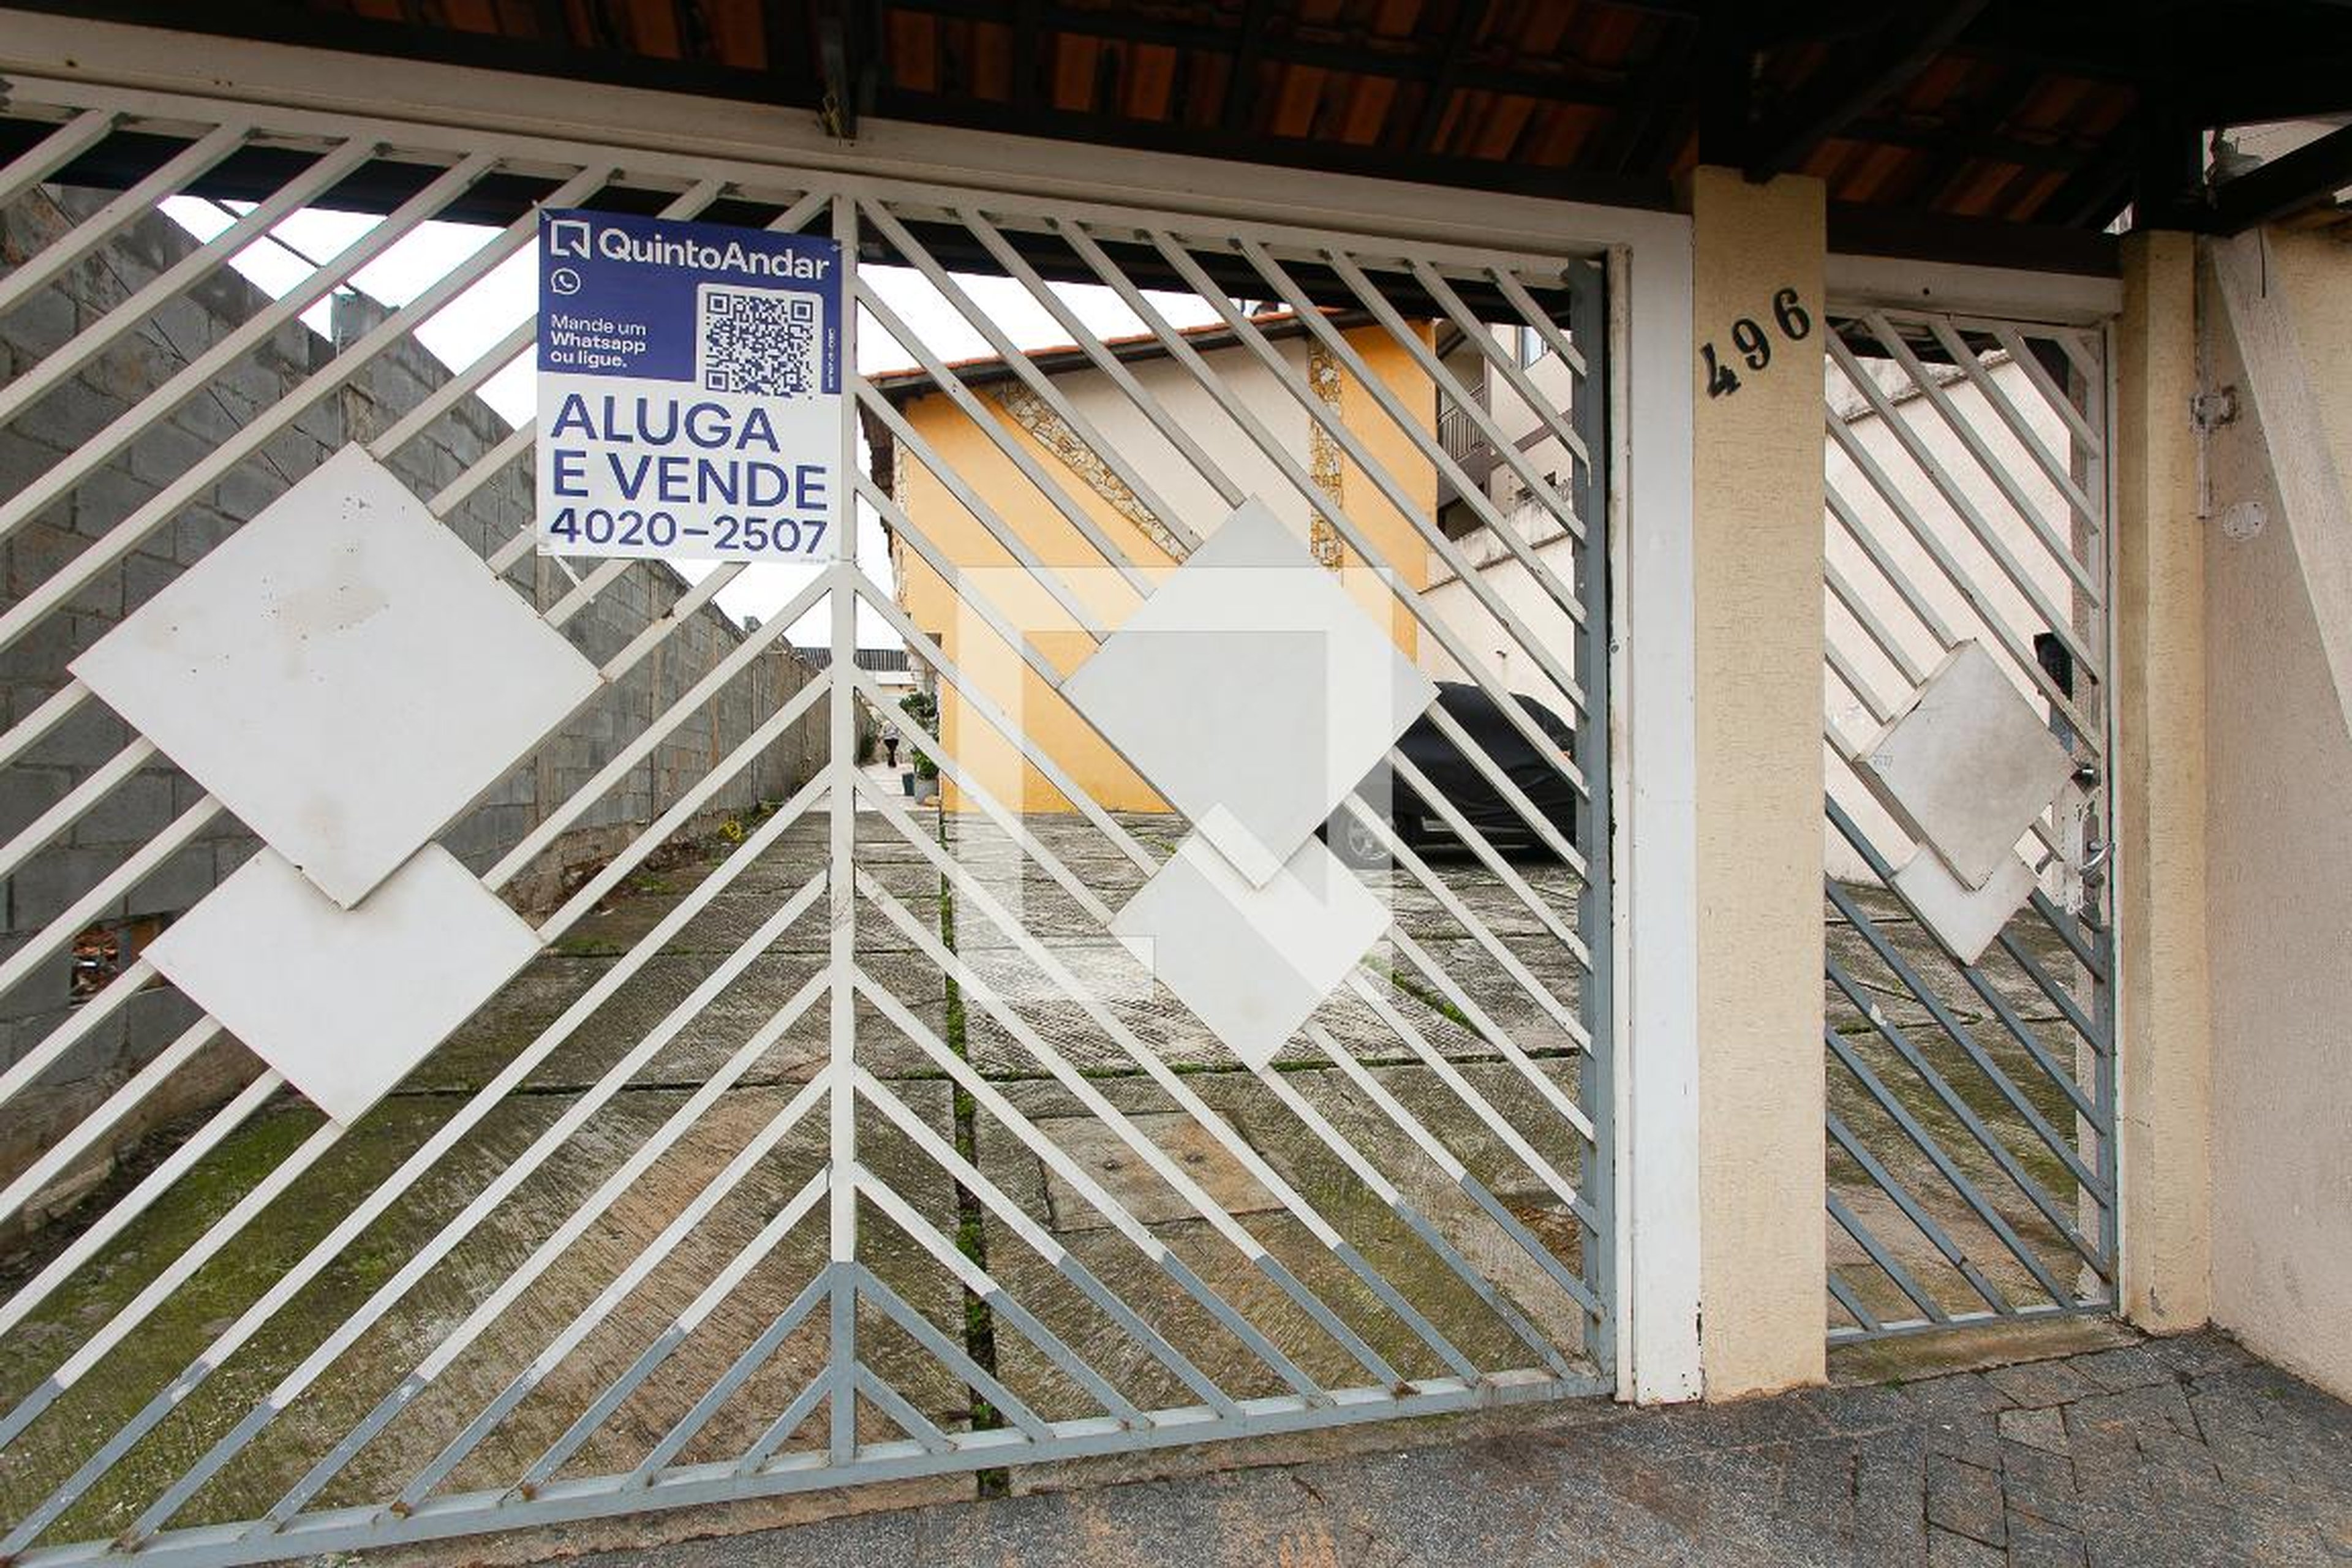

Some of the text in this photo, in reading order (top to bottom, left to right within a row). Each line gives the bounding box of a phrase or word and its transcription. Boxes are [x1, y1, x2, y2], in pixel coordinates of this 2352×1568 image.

[597, 227, 831, 281] QuintoAndar
[551, 313, 647, 336] Mande um
[551, 330, 647, 355] Whatsapp
[1699, 287, 1811, 399] 496
[551, 349, 628, 369] ou ligue.
[551, 392, 781, 453] ALUGA
[553, 448, 828, 511] E VENDE
[550, 507, 828, 554] 4020-2507
